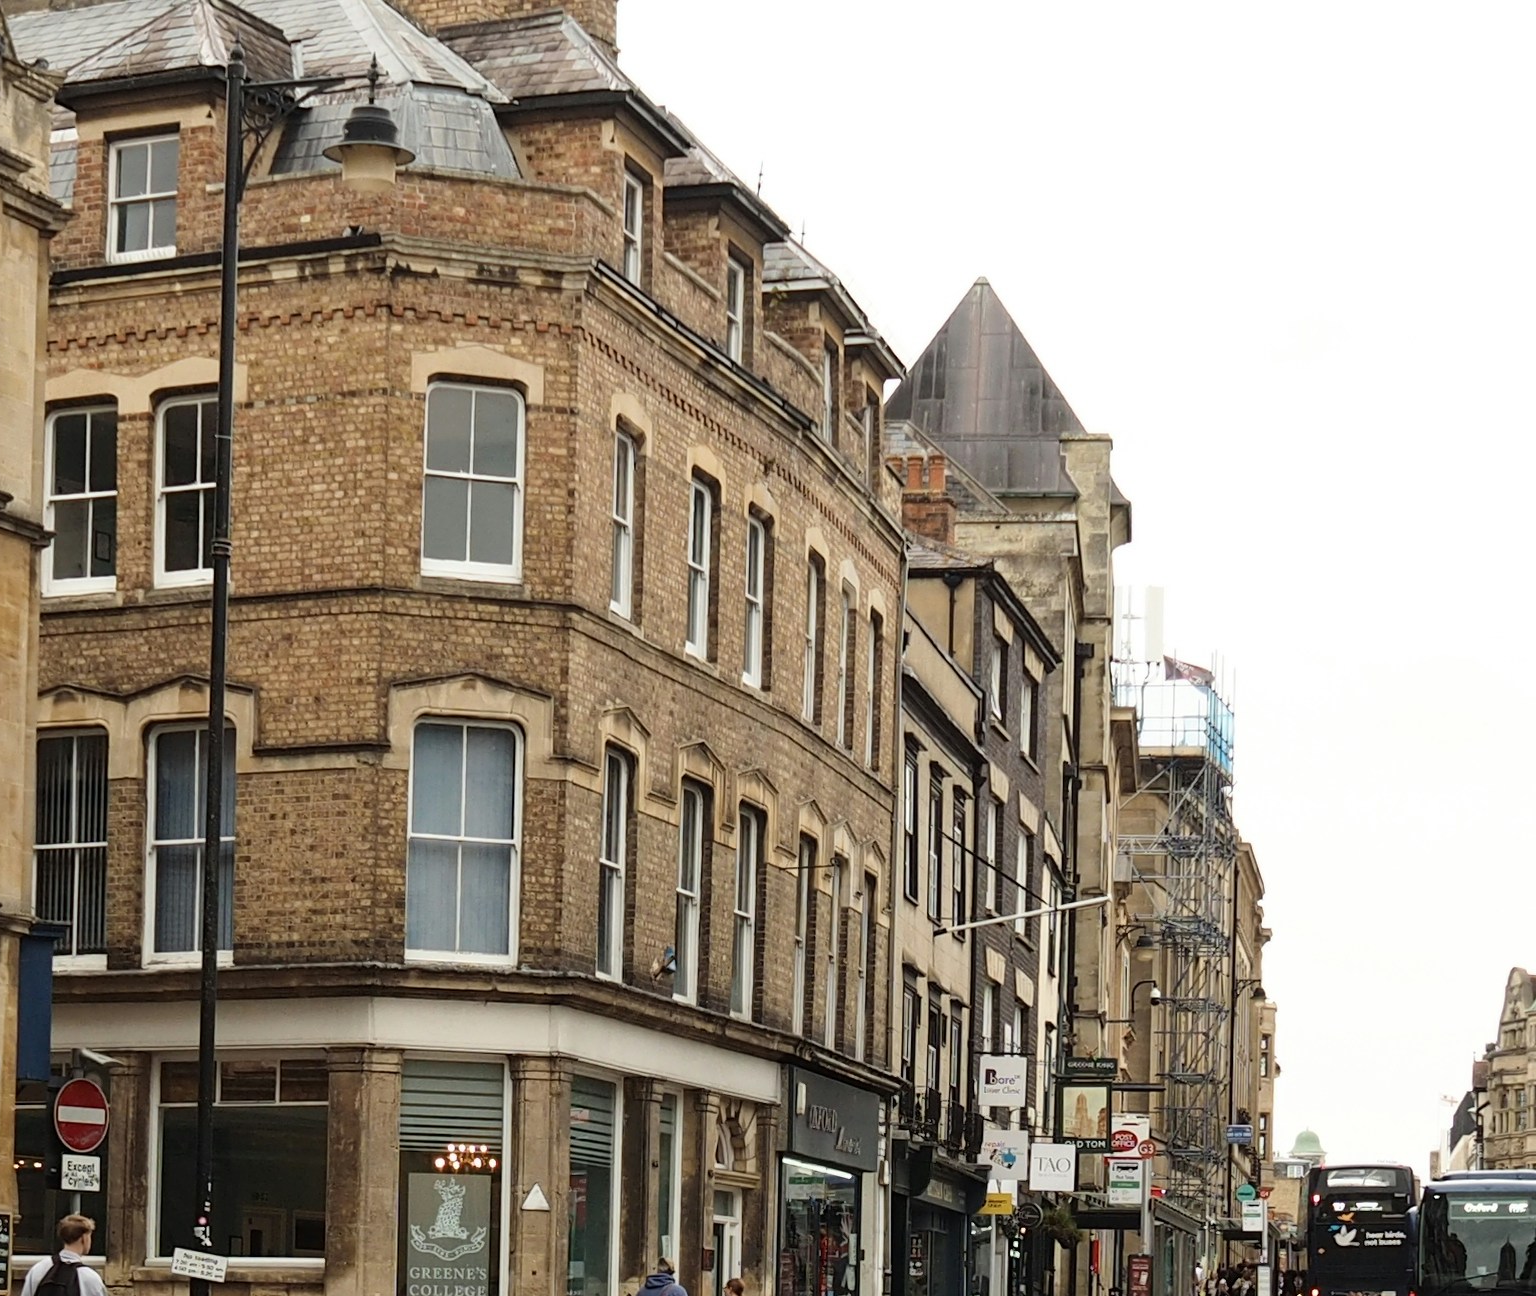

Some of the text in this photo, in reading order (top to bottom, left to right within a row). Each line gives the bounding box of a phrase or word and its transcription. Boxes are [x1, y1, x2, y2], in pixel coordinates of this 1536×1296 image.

[1085, 1140, 1106, 1148] TOM
[1111, 1140, 1135, 1148] OFFICE
[1140, 1143, 1154, 1154] G3
[67, 1160, 96, 1174] Except
[1034, 1156, 1071, 1173] TAO
[1464, 1202, 1498, 1213] Oxford
[409, 1266, 487, 1280] GREENE'S
